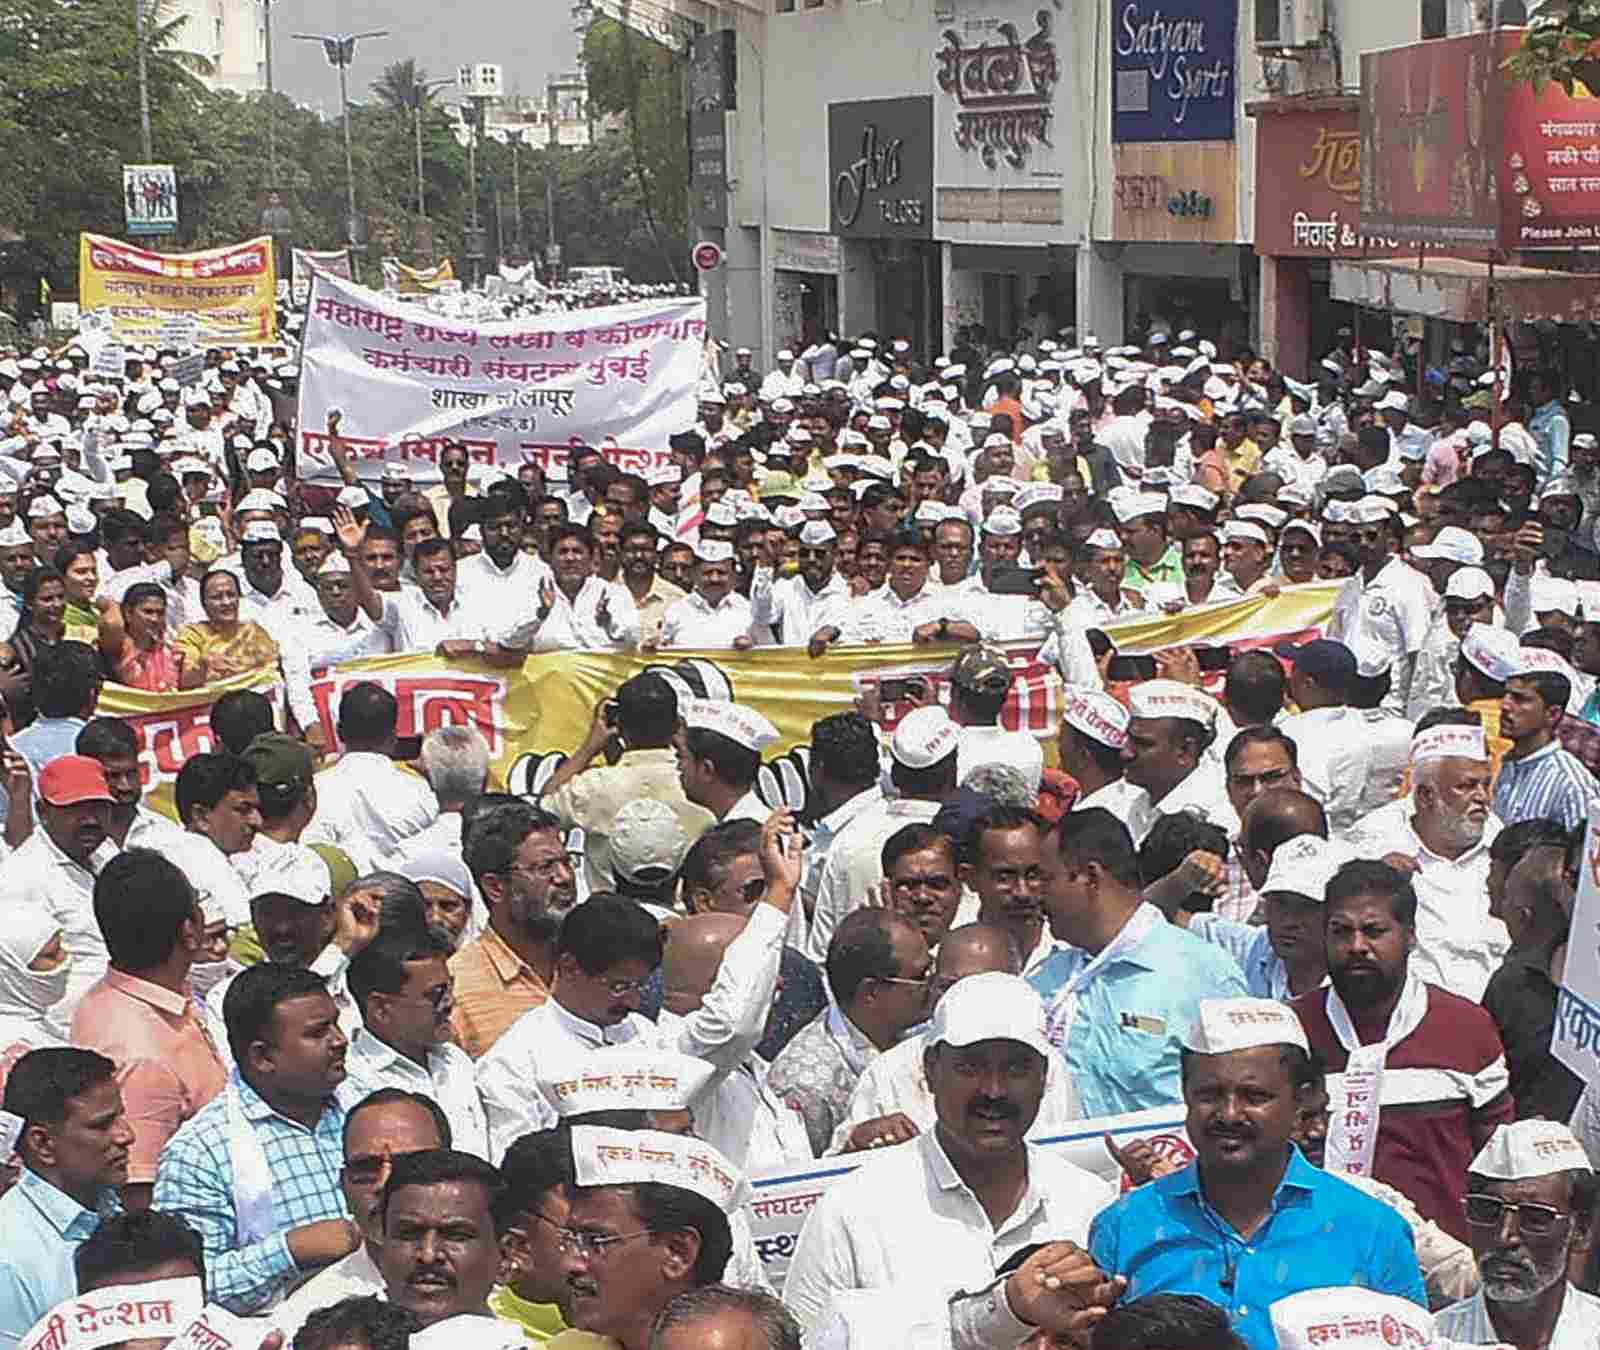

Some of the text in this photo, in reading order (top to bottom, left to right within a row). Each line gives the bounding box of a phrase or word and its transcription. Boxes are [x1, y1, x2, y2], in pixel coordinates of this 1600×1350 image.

[1118, 4, 1204, 80] Satyam
[1169, 57, 1229, 123] Sports
[1293, 211, 1360, 251] मिठाई &
[1520, 226, 1592, 239] Please Join
[431, 388, 489, 409] शाखा
